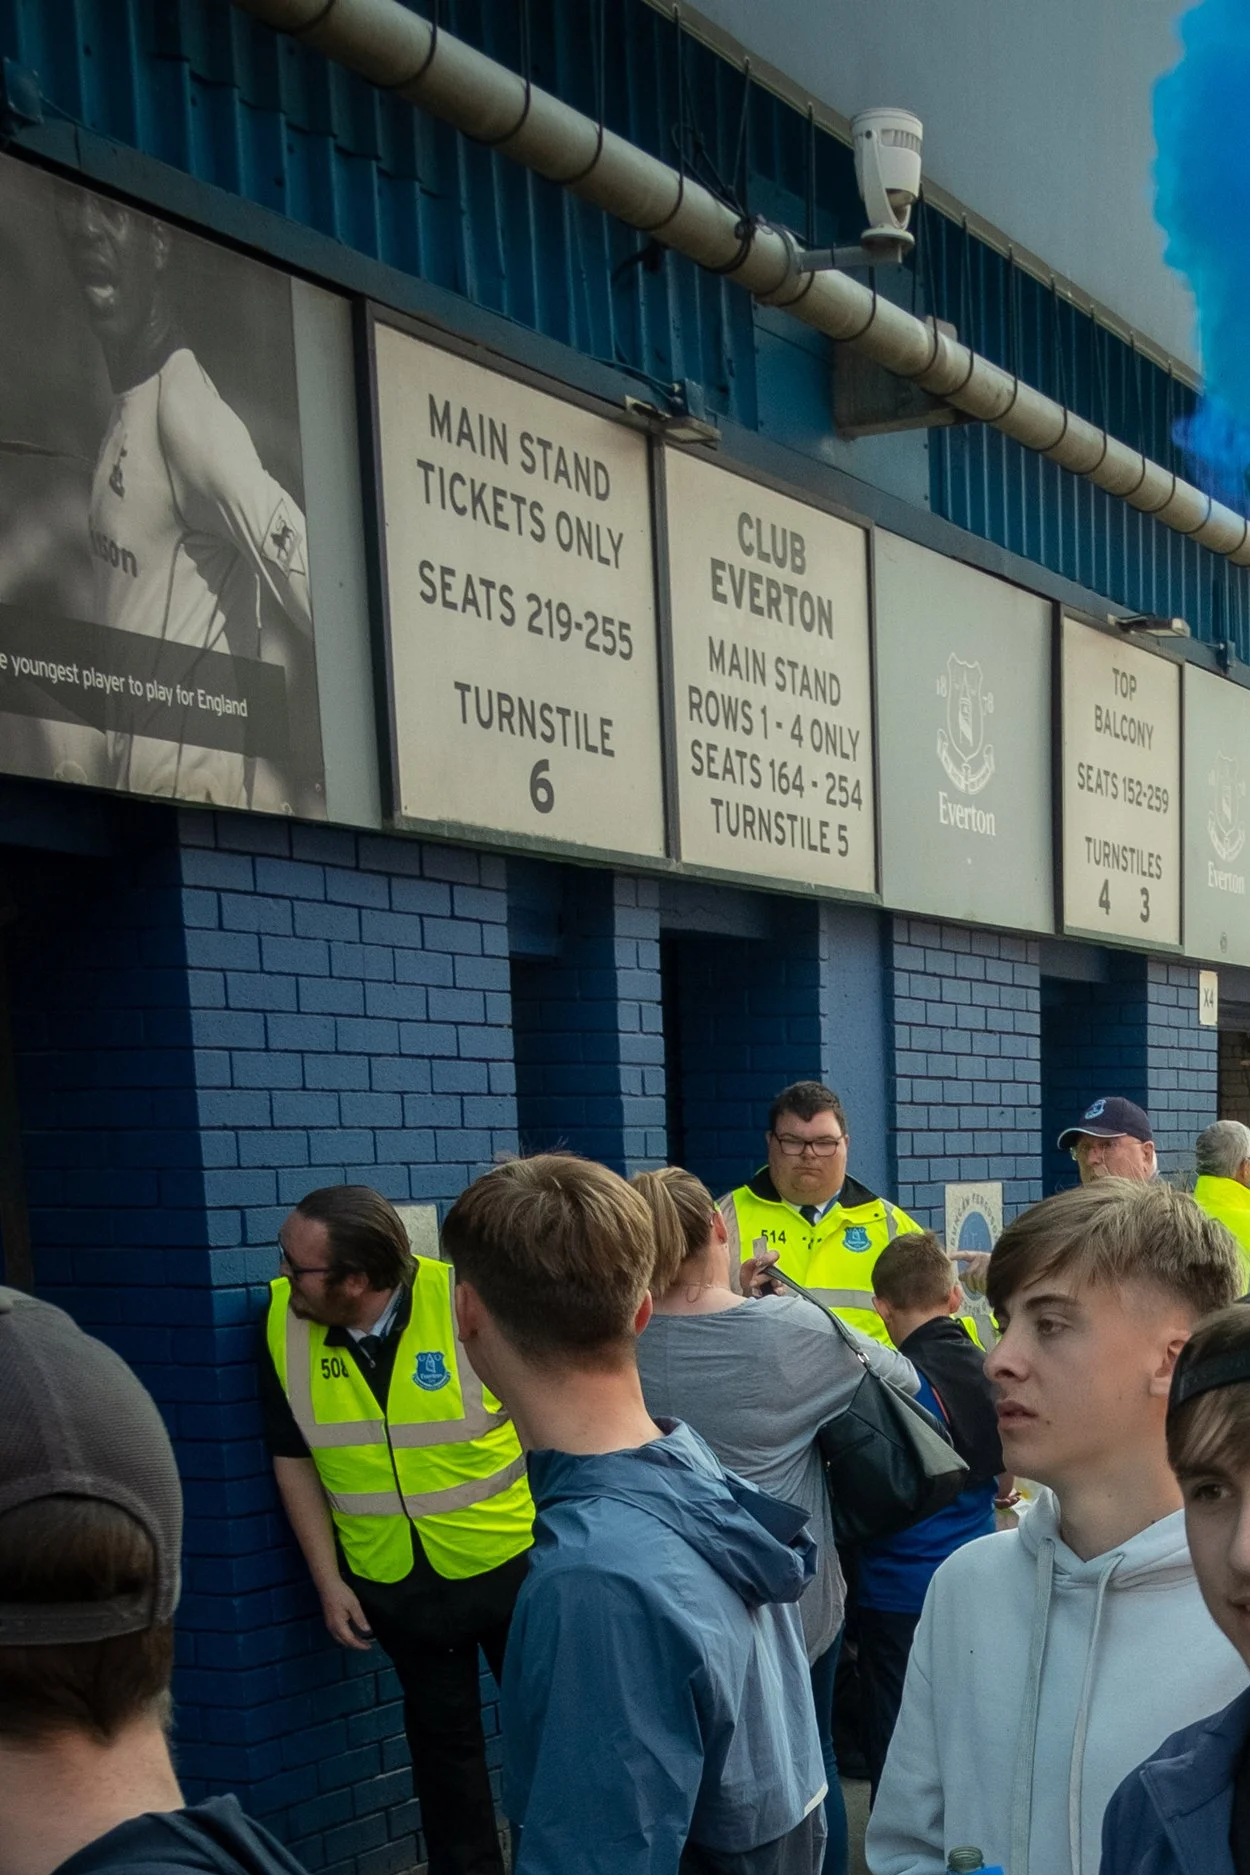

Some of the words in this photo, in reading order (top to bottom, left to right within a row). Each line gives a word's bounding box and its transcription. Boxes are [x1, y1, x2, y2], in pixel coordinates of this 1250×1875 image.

[428, 393, 508, 465] MAIN
[519, 431, 610, 501] STAND
[416, 458, 546, 543] TICKETS
[556, 511, 624, 569] ONLY
[737, 511, 806, 575] CLUB
[418, 560, 516, 627] SEATS
[526, 593, 633, 660] 219-255
[710, 557, 834, 640] EVERTON
[11, 655, 80, 684] youngest
[83, 667, 125, 694] player
[129, 675, 143, 696] to
[146, 680, 174, 706] play
[175, 683, 195, 705] for
[197, 689, 248, 717] England
[708, 636, 766, 687] MAIN
[775, 656, 841, 707] STAND
[1112, 667, 1137, 701] TOP
[454, 681, 615, 758] TURNSTILE
[688, 685, 754, 736] ROWS
[760, 705, 768, 739] 1
[790, 714, 803, 748] 4
[810, 718, 860, 762] ONLY
[1095, 704, 1154, 750] BALCONY
[529, 758, 554, 814] 6
[691, 739, 762, 789] SEATS
[769, 758, 804, 798] 164
[825, 772, 862, 811] 254
[1077, 761, 1118, 800] SEATS
[1122, 776, 1169, 814] 152-259
[710, 797, 830, 854] TURNSTILE
[838, 823, 849, 857] 5
[938, 791, 996, 836] Everton
[1085, 836, 1162, 880] TURNSTILES
[1207, 861, 1246, 895] Everton
[1098, 878, 1111, 916] 4
[1139, 887, 1150, 923] 3
[761, 1229, 786, 1244] 514
